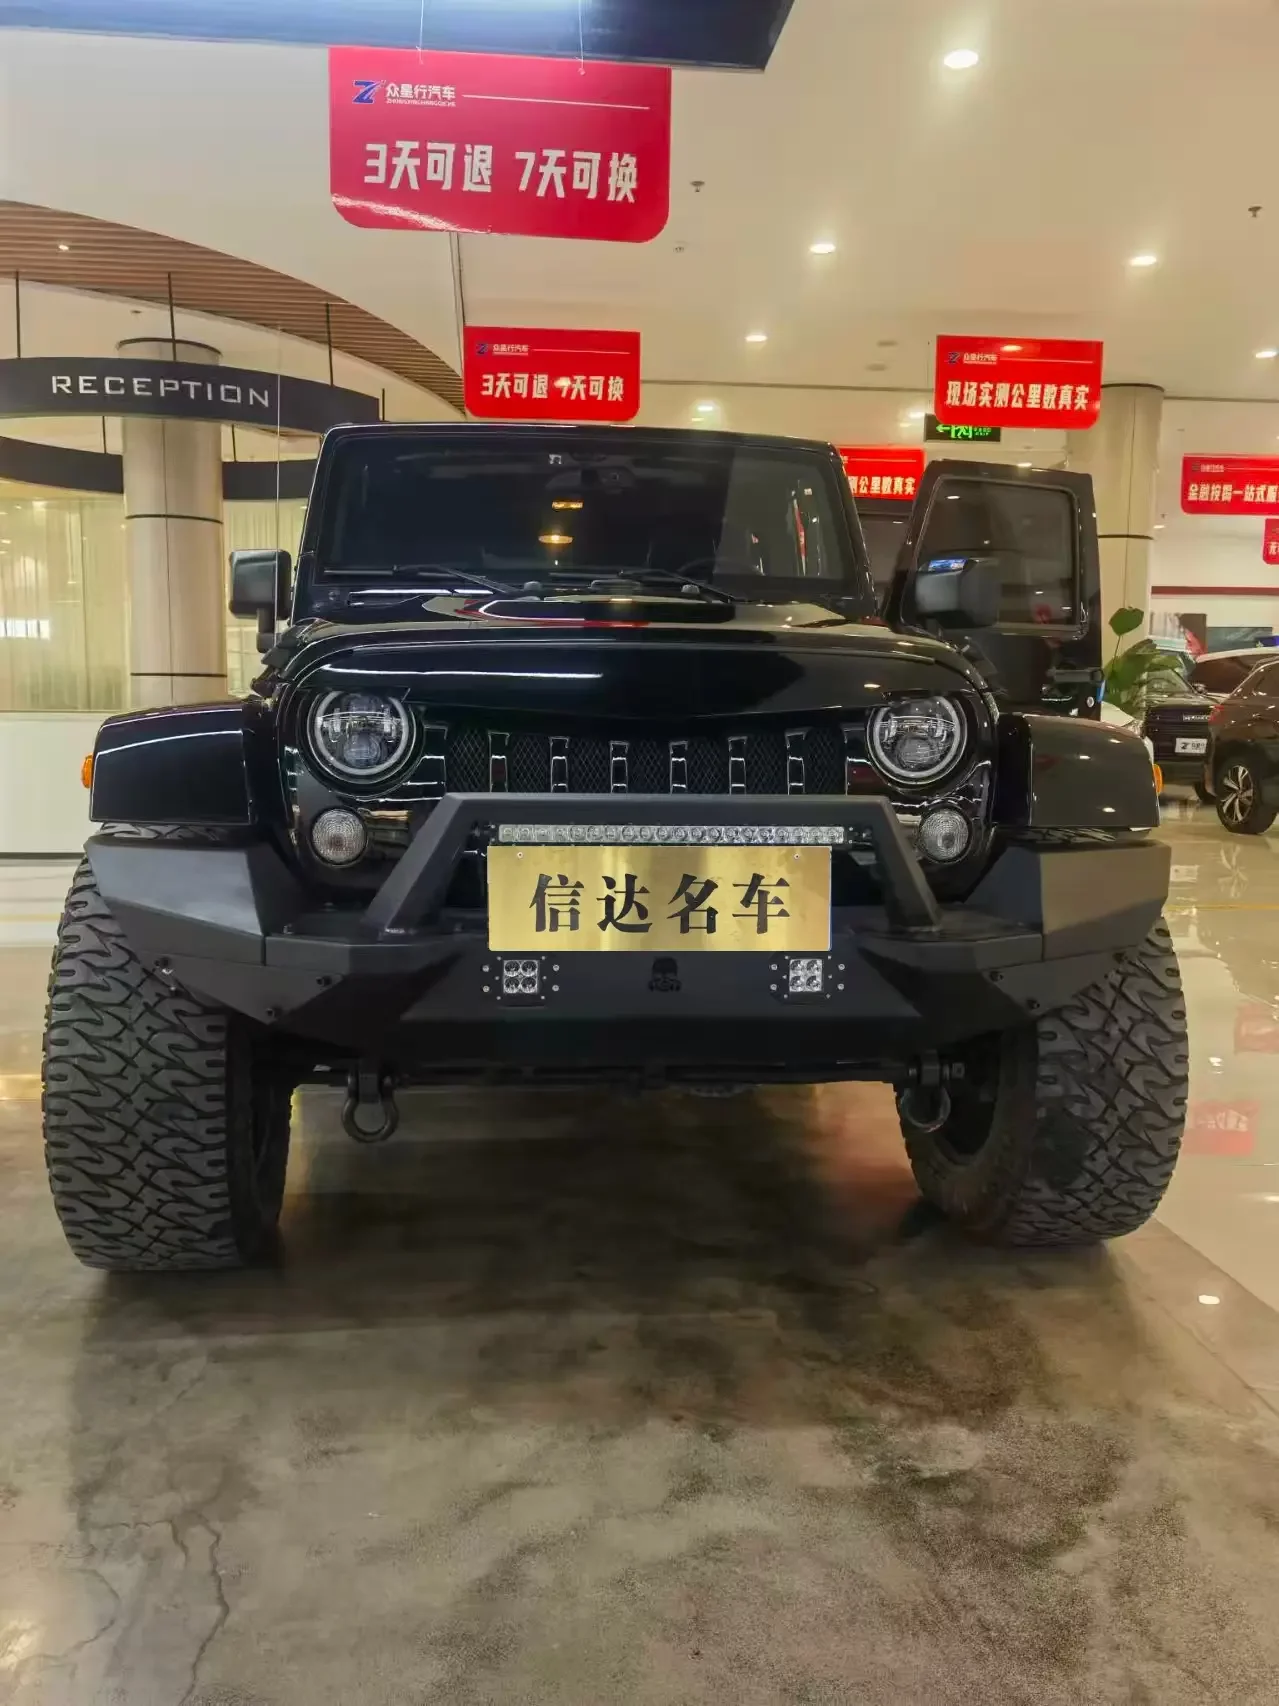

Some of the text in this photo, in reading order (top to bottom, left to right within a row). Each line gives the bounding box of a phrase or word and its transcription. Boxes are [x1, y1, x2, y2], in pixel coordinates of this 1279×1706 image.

[385, 82, 456, 100] 众星行汽车
[364, 140, 638, 203] 3天可退 7天可换
[51, 374, 270, 408] RECEPTION
[481, 372, 625, 401] 3天可退 7天可换
[945, 380, 1090, 411] 现场实测公里数真实
[1187, 483, 1279, 503] 金融按揭一站式服
[528, 873, 791, 934] 信达名车
